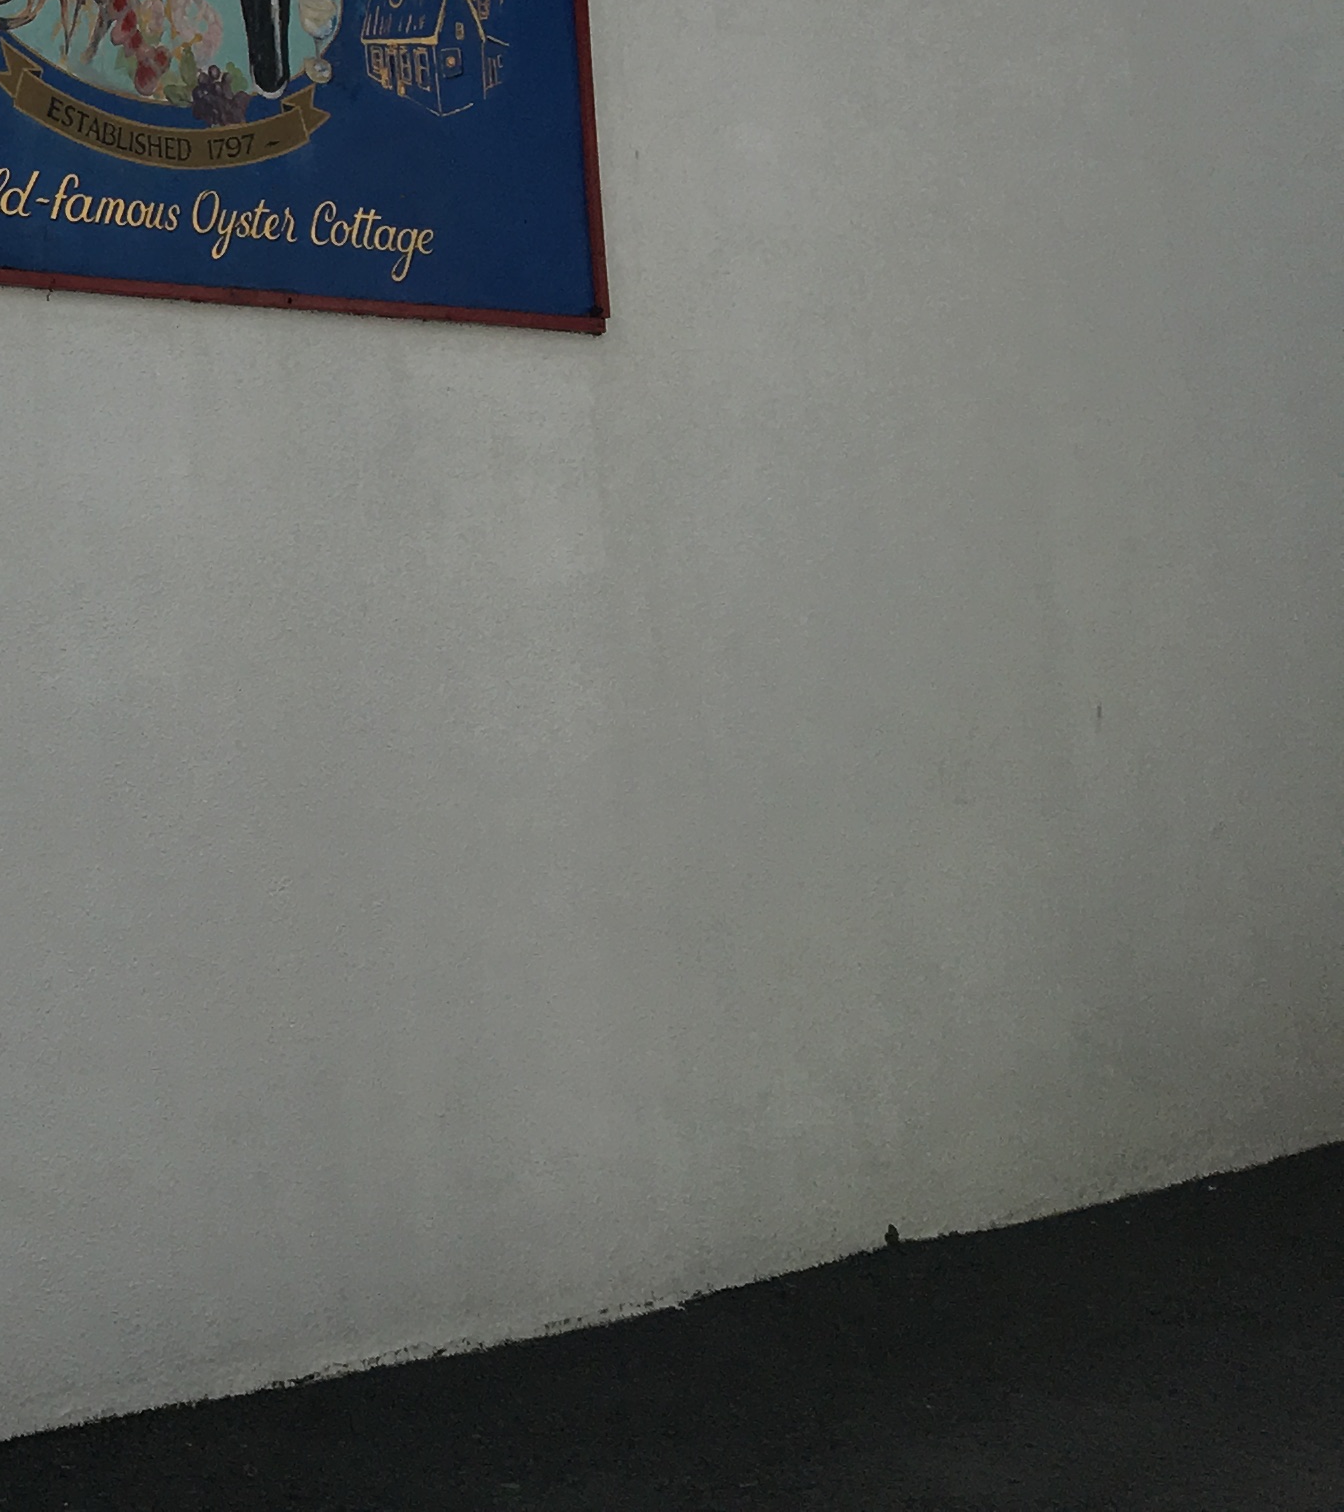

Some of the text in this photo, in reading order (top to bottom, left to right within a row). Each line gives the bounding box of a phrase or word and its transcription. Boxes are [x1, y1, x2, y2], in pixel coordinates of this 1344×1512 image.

[46, 96, 255, 162] ESTABLISHED 1797
[192, 189, 298, 260] Oyster
[310, 200, 435, 282] Cottage
